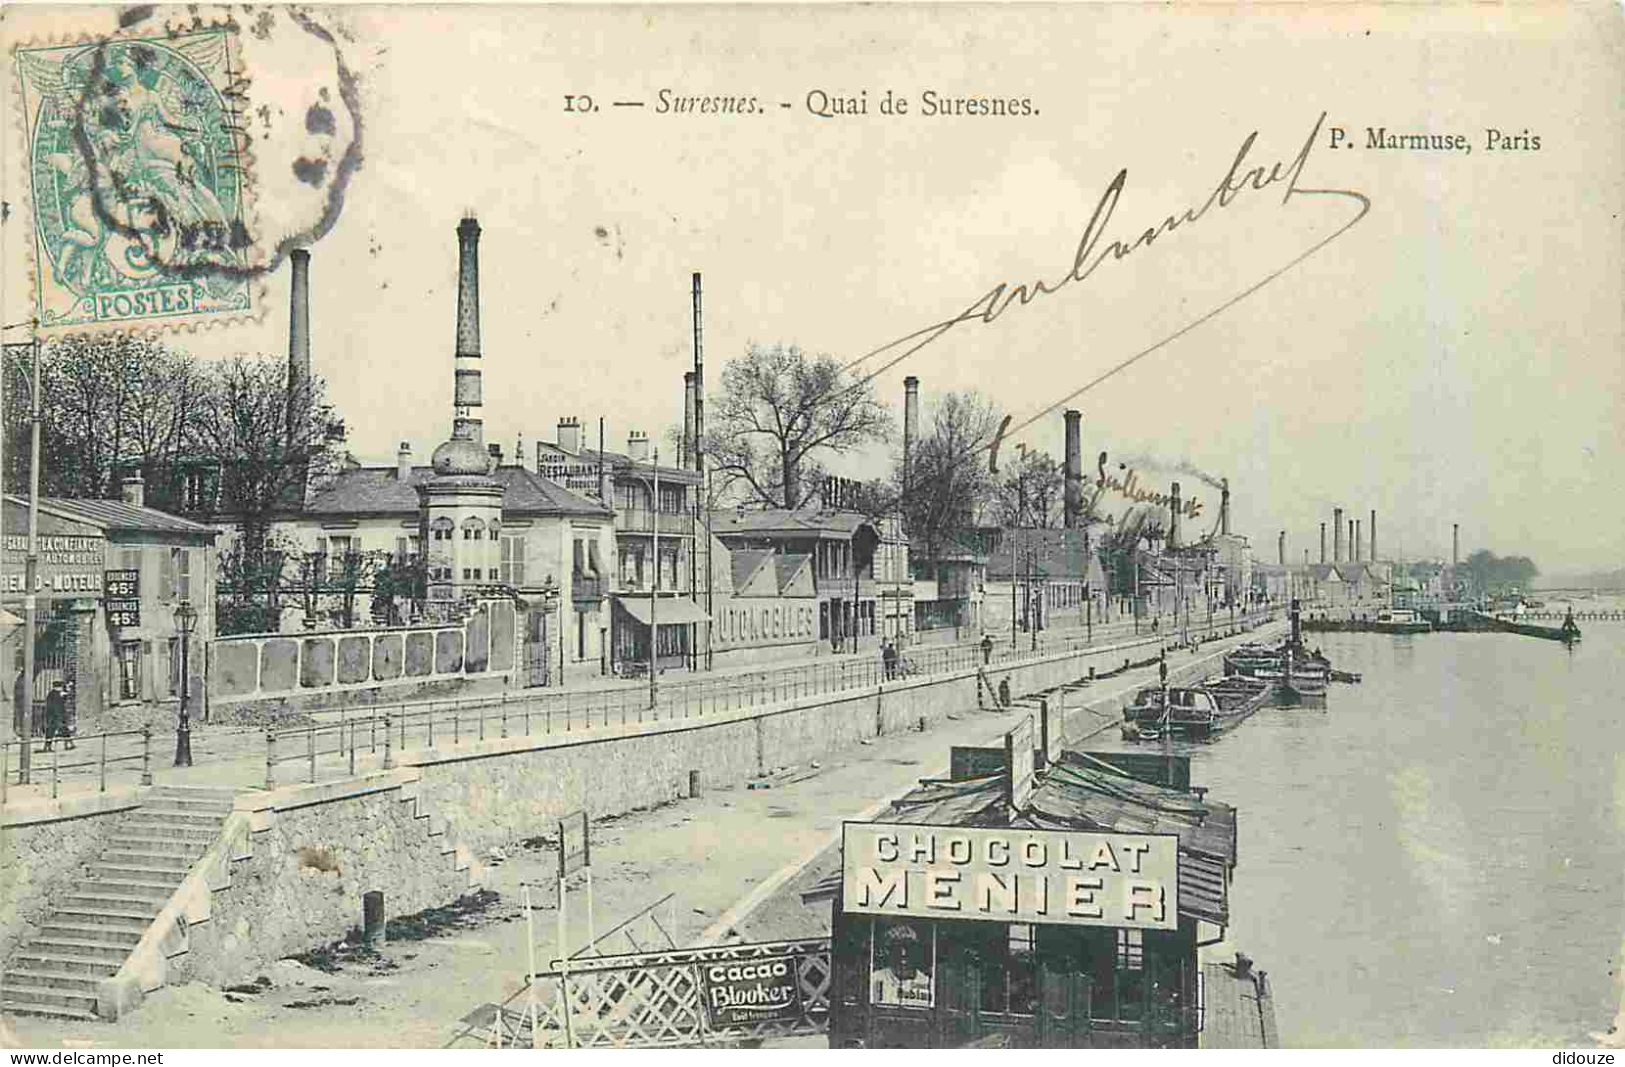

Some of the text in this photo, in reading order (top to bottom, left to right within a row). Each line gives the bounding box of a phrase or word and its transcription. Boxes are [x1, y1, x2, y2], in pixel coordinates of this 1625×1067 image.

[99, 287, 191, 319] POSTES
[875, 832, 1149, 873] CHOCOLAT
[855, 868, 1166, 923] MENIER
[710, 983, 794, 1007] Blooker
